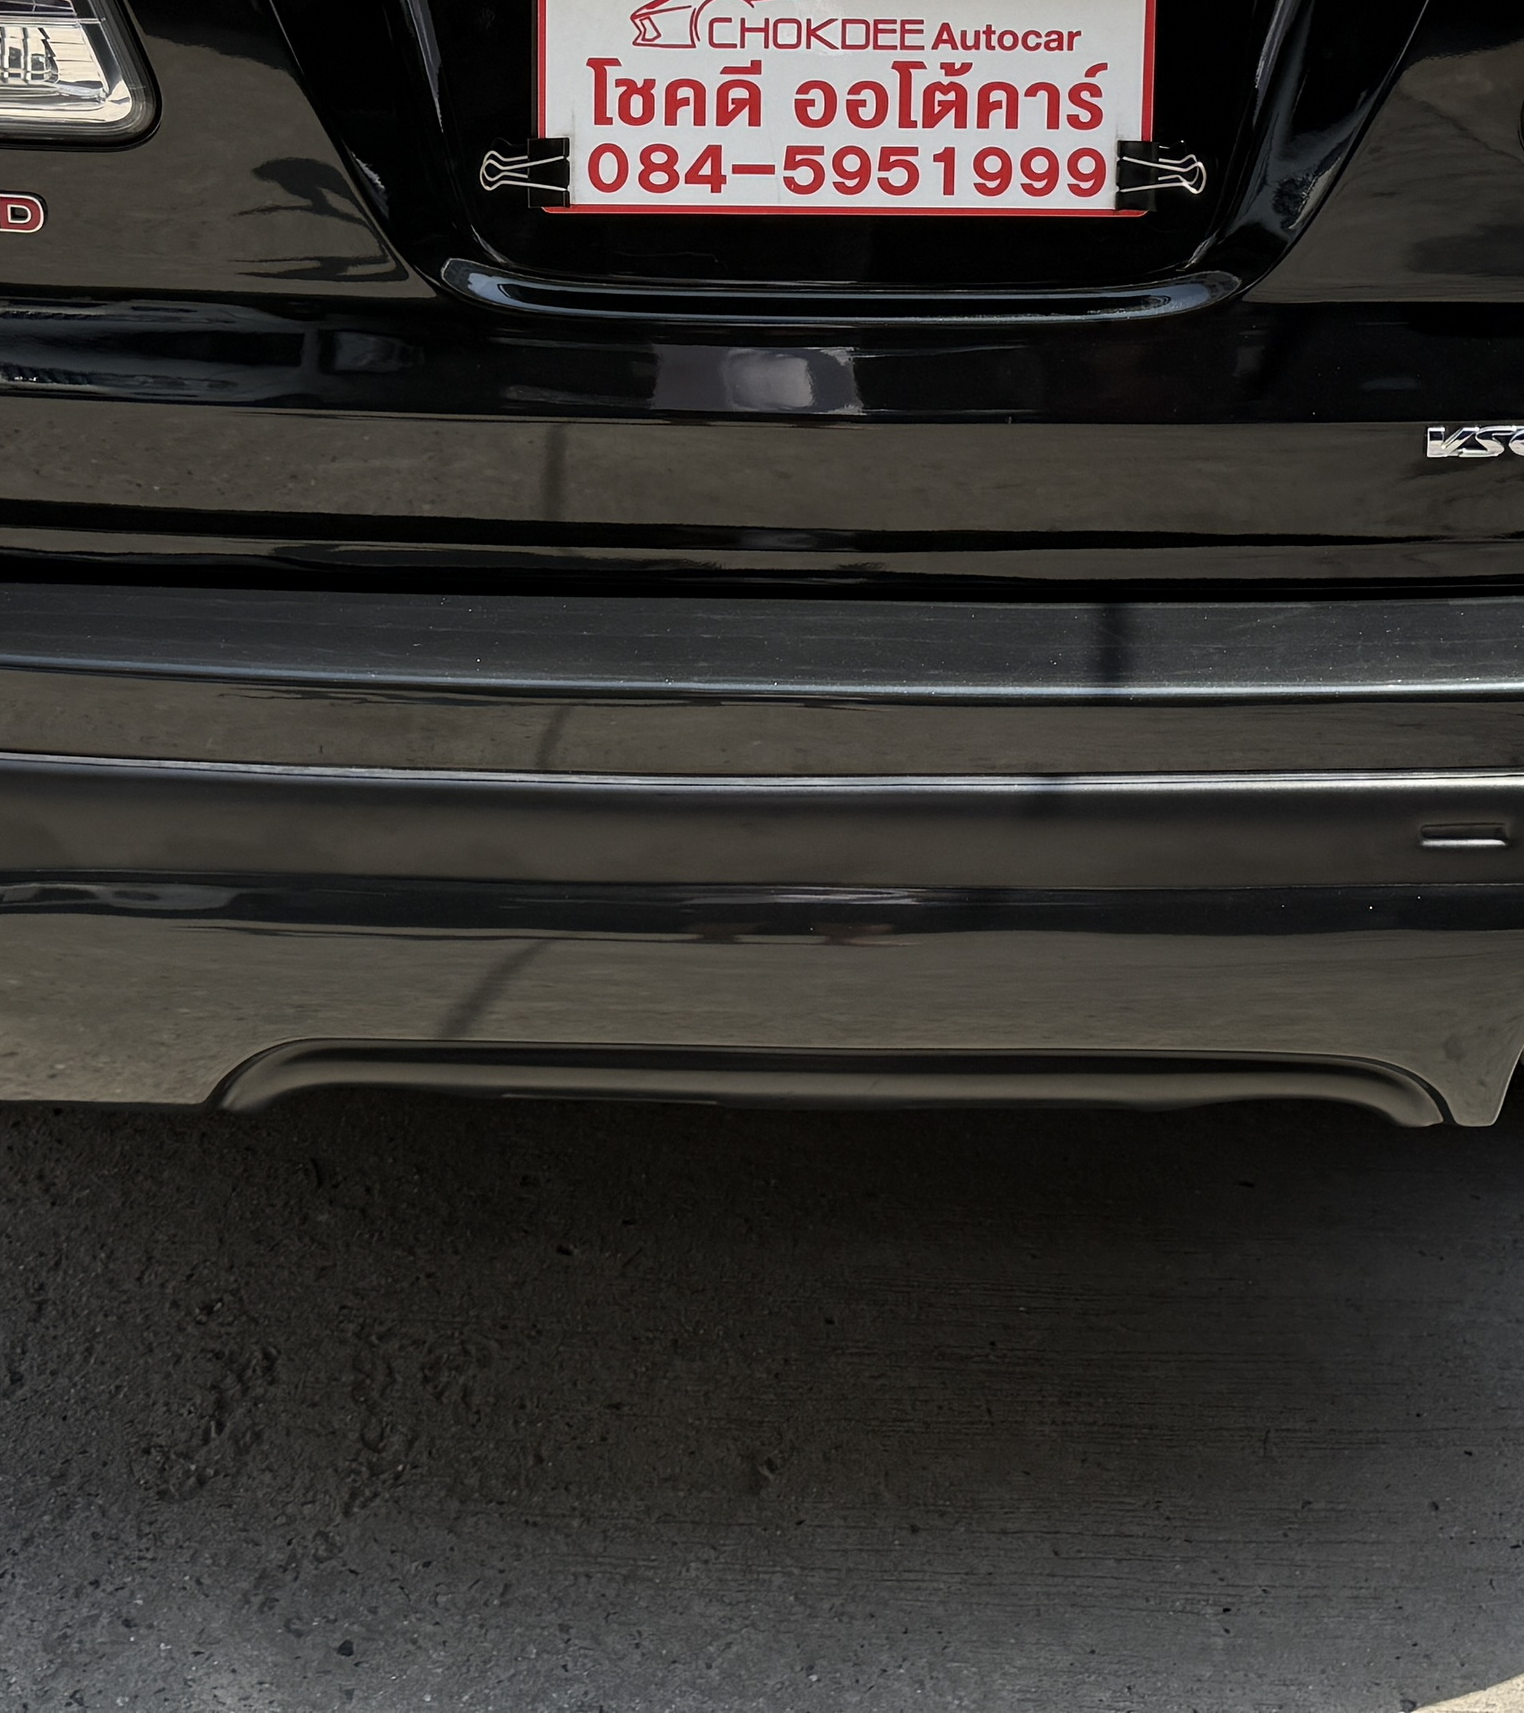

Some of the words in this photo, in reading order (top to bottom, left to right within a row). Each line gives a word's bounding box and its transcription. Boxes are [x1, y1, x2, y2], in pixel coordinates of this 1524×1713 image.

[708, 17, 925, 52] CHOKDEE
[931, 23, 1083, 52] Autocar
[586, 57, 763, 128] โชคดี
[793, 60, 1109, 131] ออโต้คาร์
[586, 142, 1109, 197] 084-5951999
